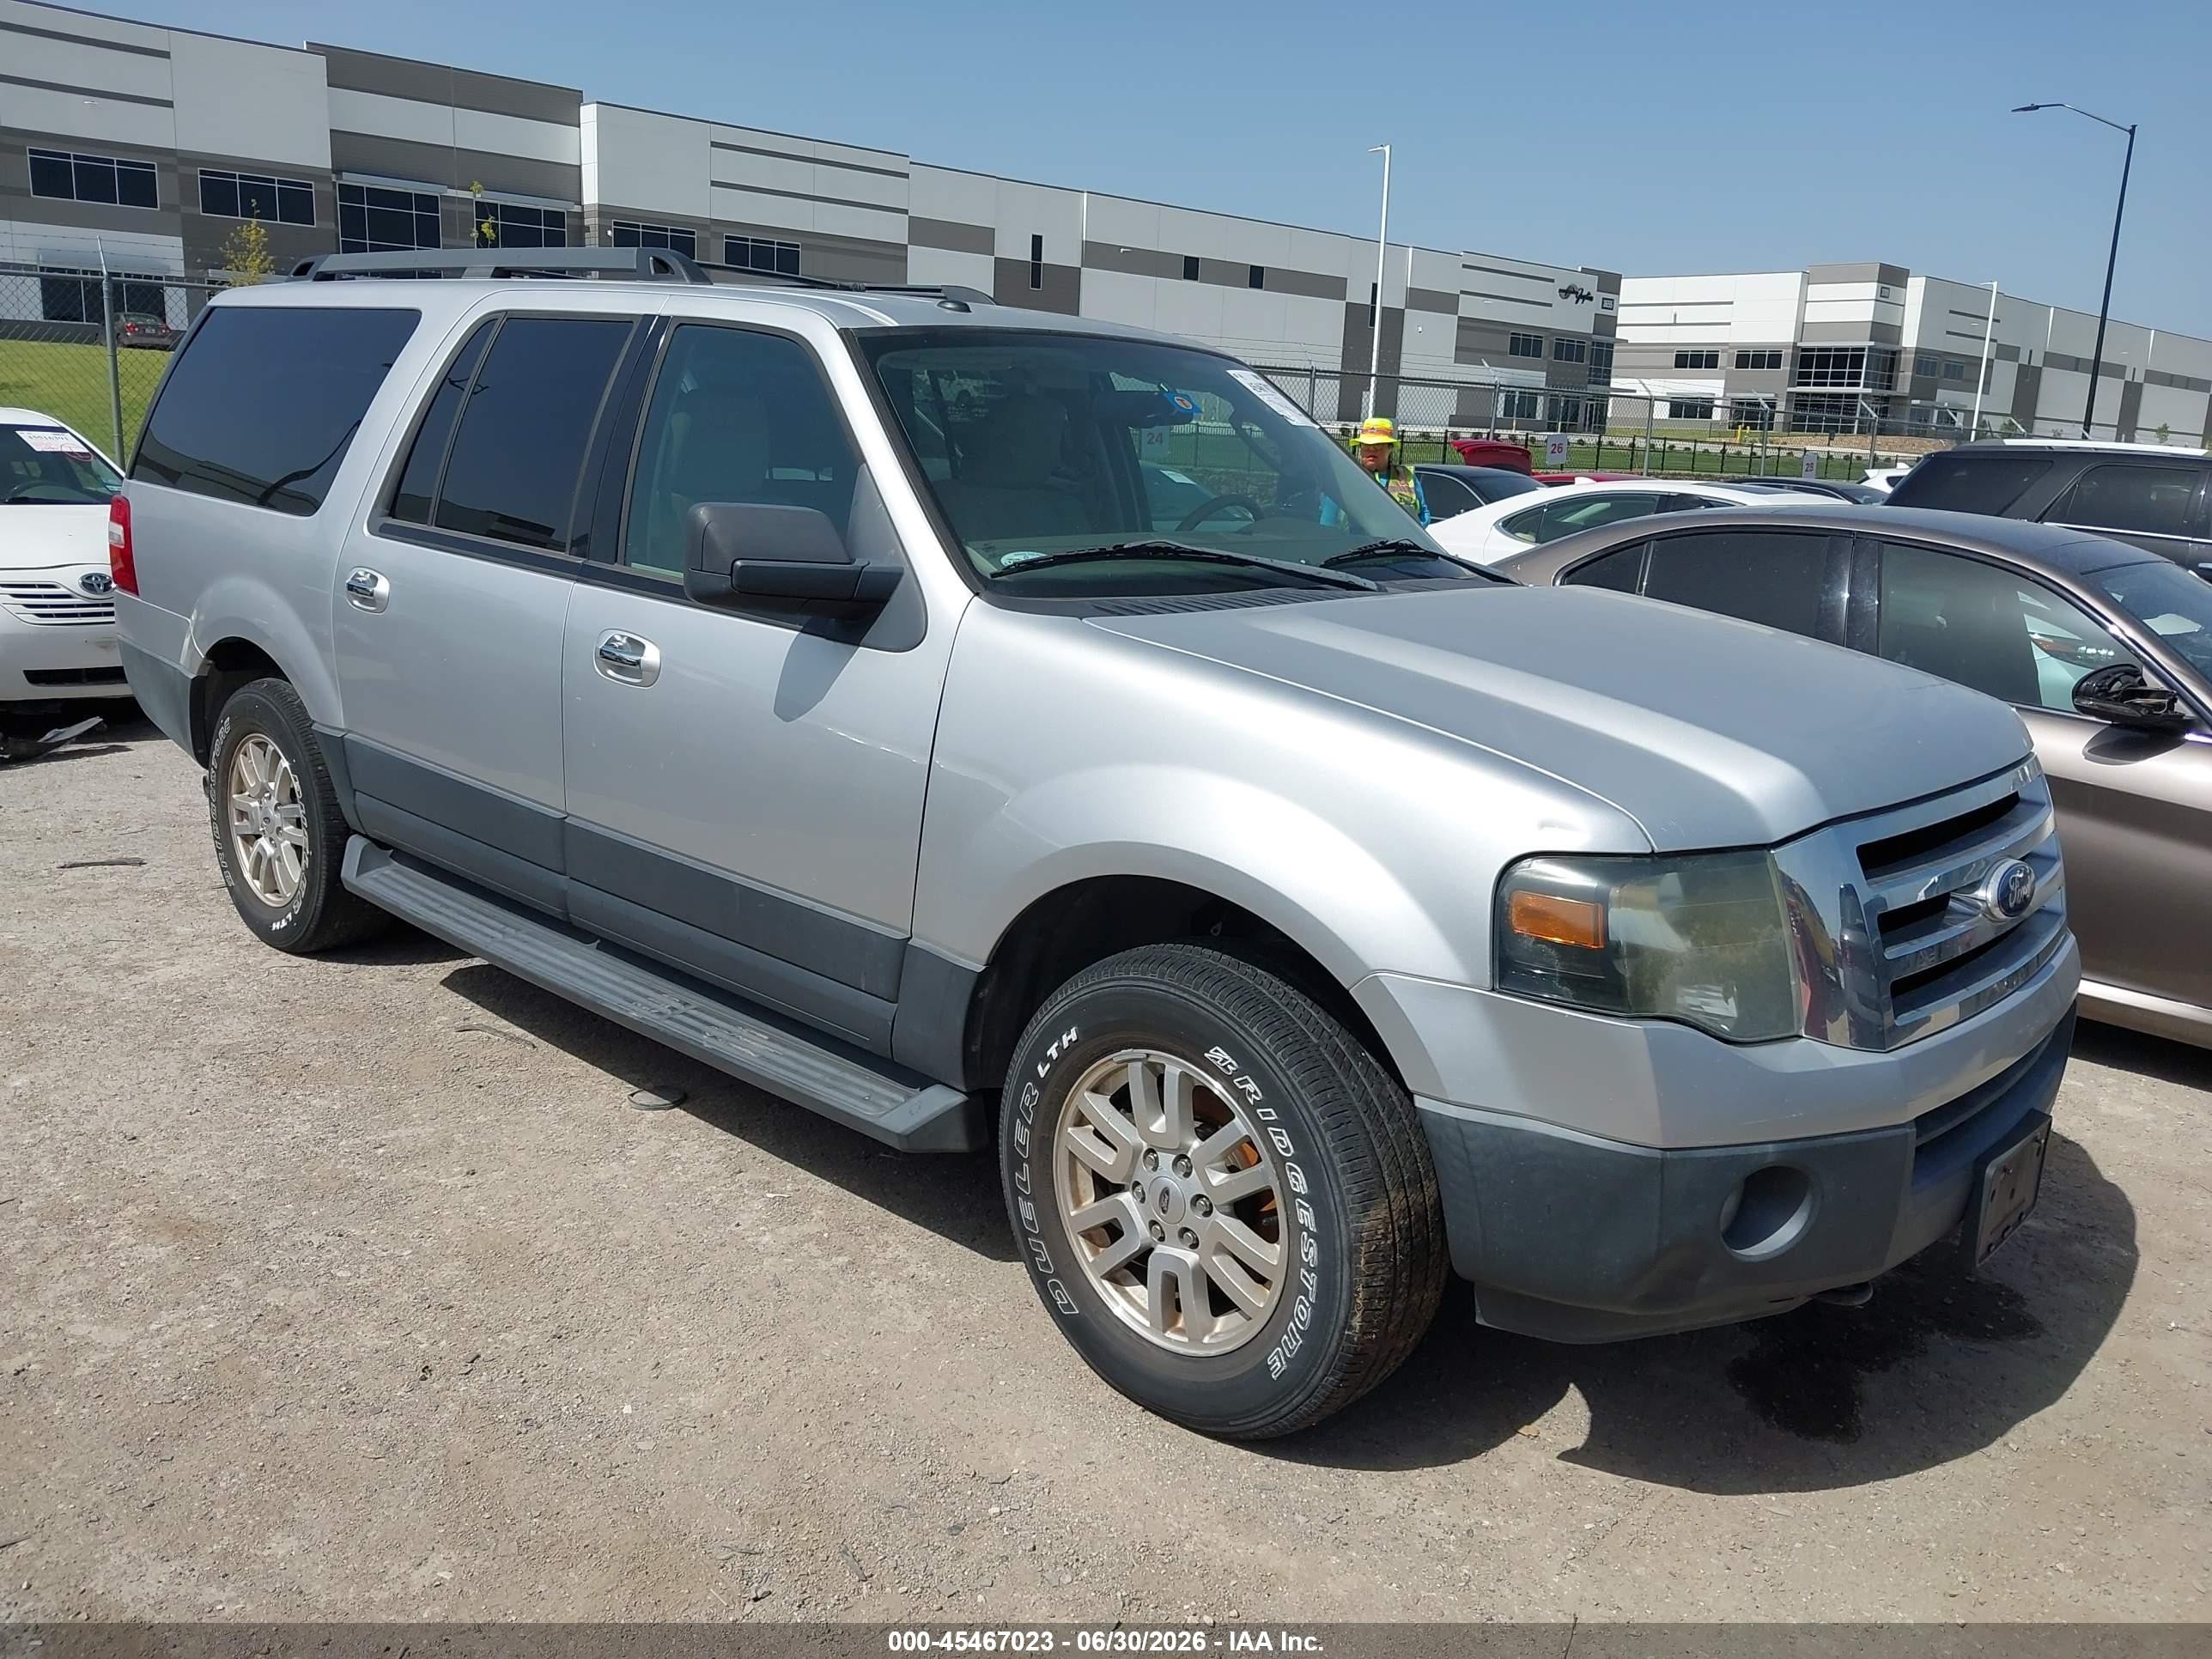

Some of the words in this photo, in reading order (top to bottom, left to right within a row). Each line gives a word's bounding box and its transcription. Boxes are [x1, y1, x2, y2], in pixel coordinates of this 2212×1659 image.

[1146, 432, 1163, 445] 24
[1551, 443, 1563, 453] 26
[1036, 1027, 1078, 1079] LTH
[1015, 1082, 1079, 1316] DUELER
[1204, 1046, 1319, 1381] BRIDGESTONE
